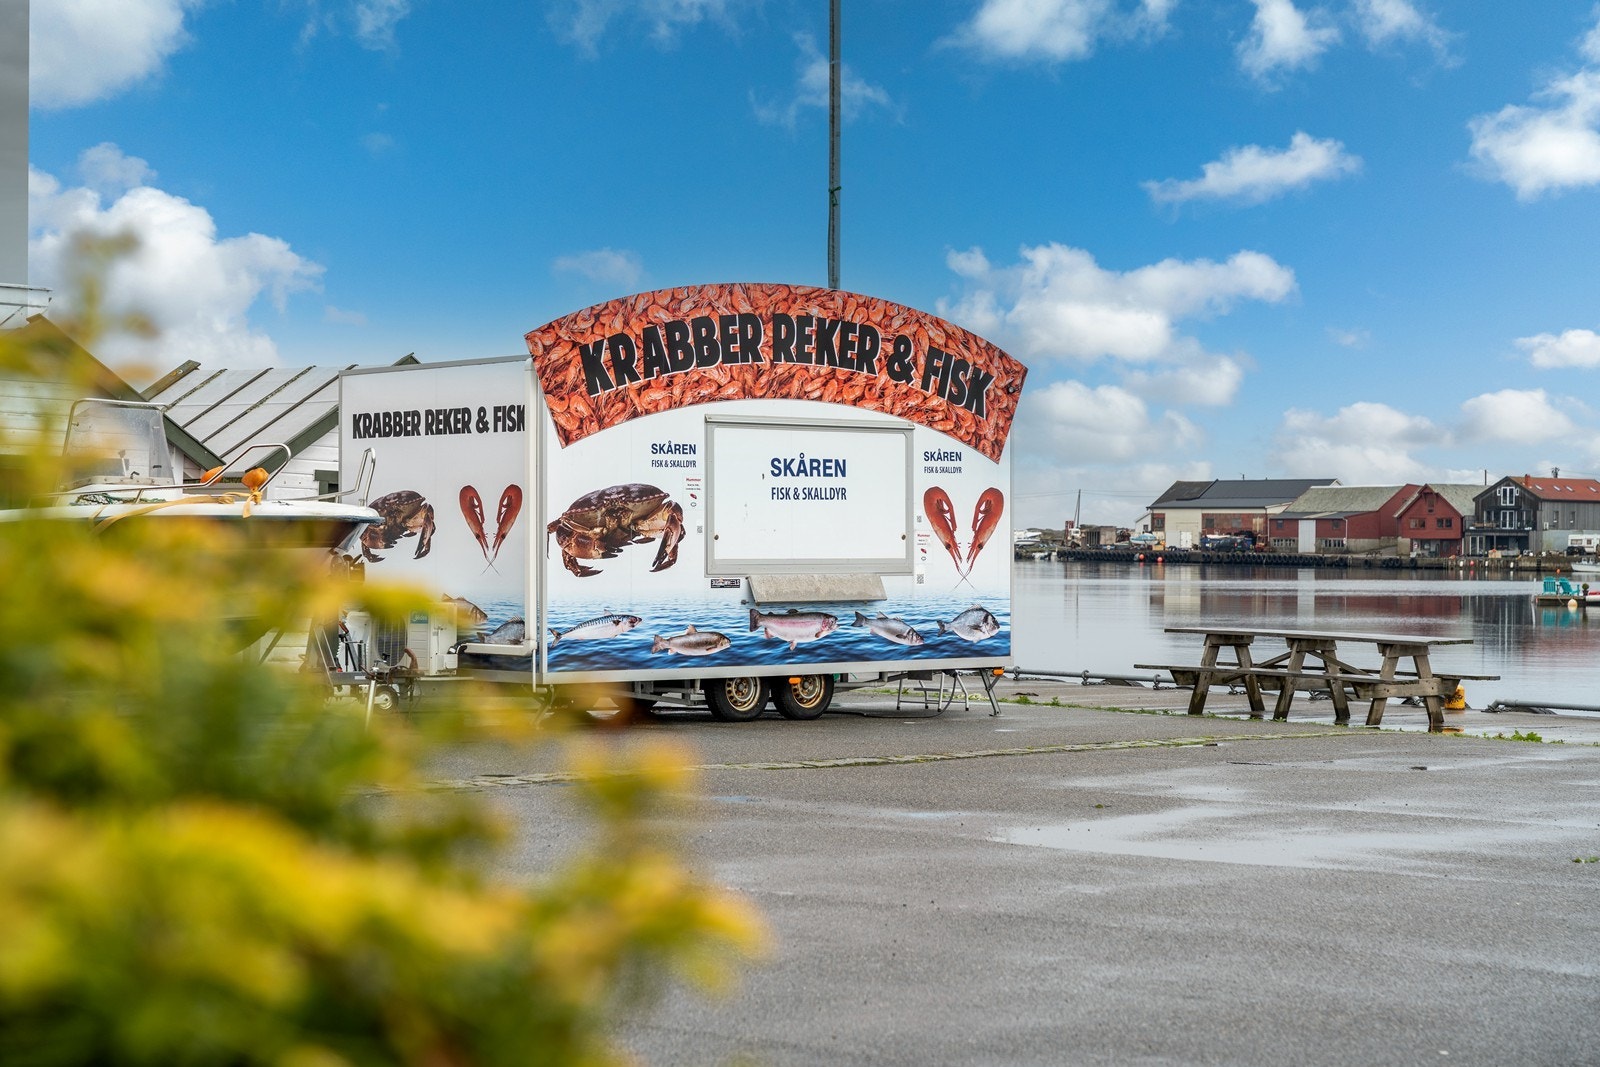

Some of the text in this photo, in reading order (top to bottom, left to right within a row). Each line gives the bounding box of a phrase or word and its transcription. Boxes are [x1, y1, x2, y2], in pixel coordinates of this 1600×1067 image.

[579, 312, 995, 420] KRABBER REKER & FISK
[352, 409, 421, 439] KRABBER
[424, 407, 472, 436] REKER
[475, 406, 490, 433] &
[651, 440, 696, 455] SKÅREN
[923, 448, 962, 461] SKÅREN
[770, 452, 847, 477] SKÅREN
[771, 487, 848, 501] FISK & SKALLDYR
